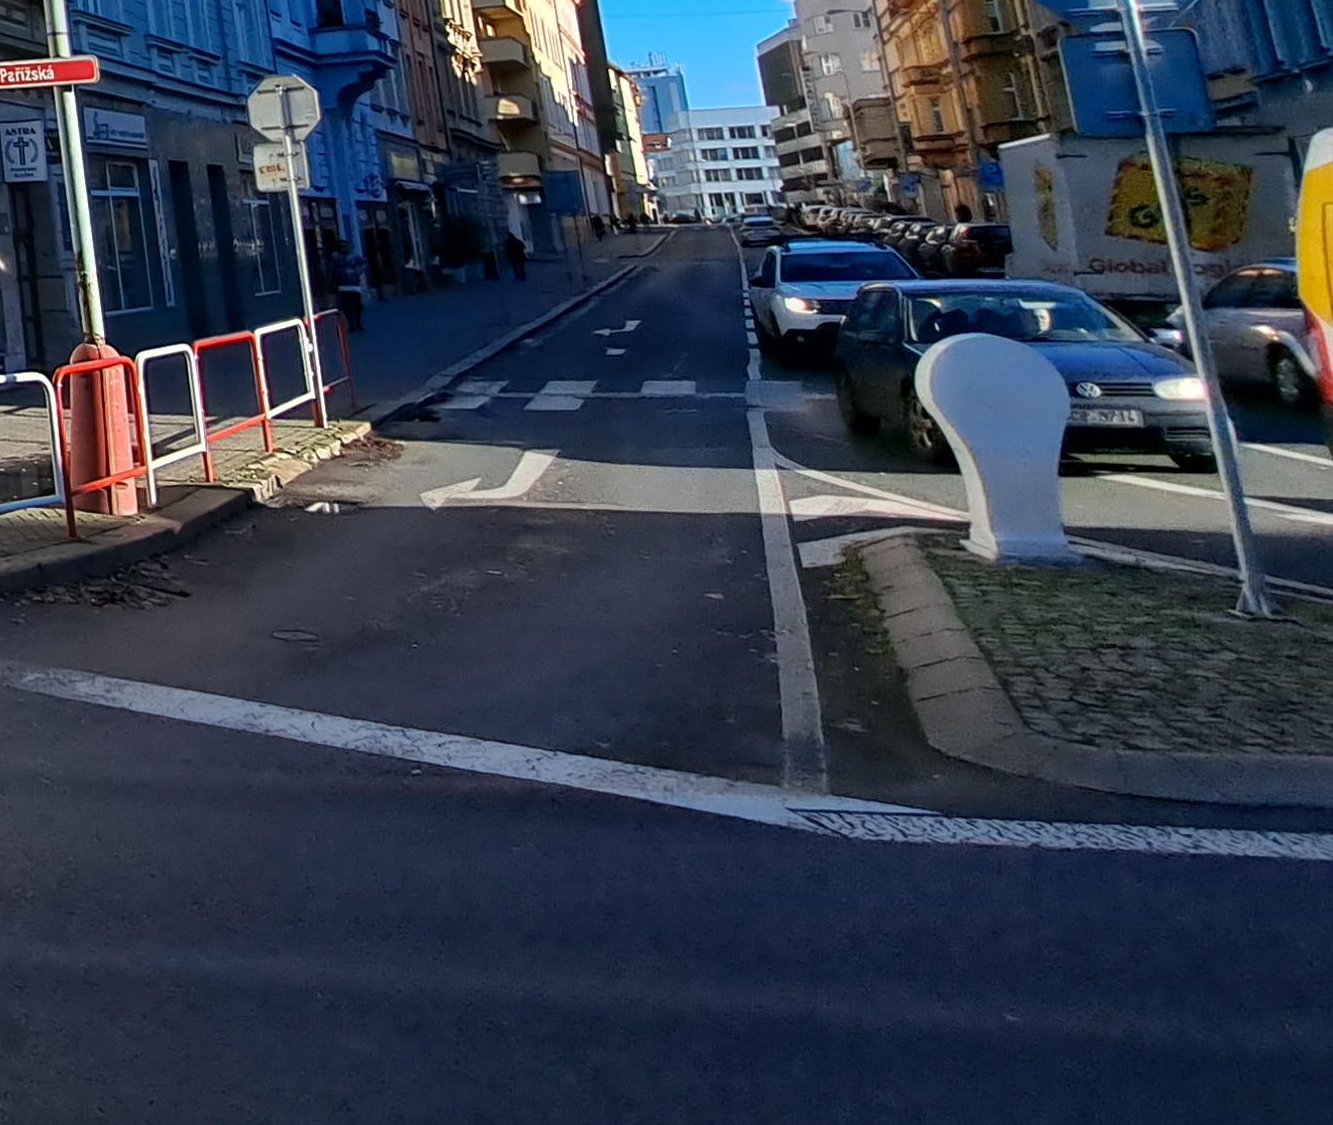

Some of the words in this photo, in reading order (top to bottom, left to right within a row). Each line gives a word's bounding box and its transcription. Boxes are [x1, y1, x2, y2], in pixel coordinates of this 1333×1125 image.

[0, 65, 54, 83] Pařížská
[5, 127, 36, 136] ASTRA
[1089, 257, 1166, 275] Global
